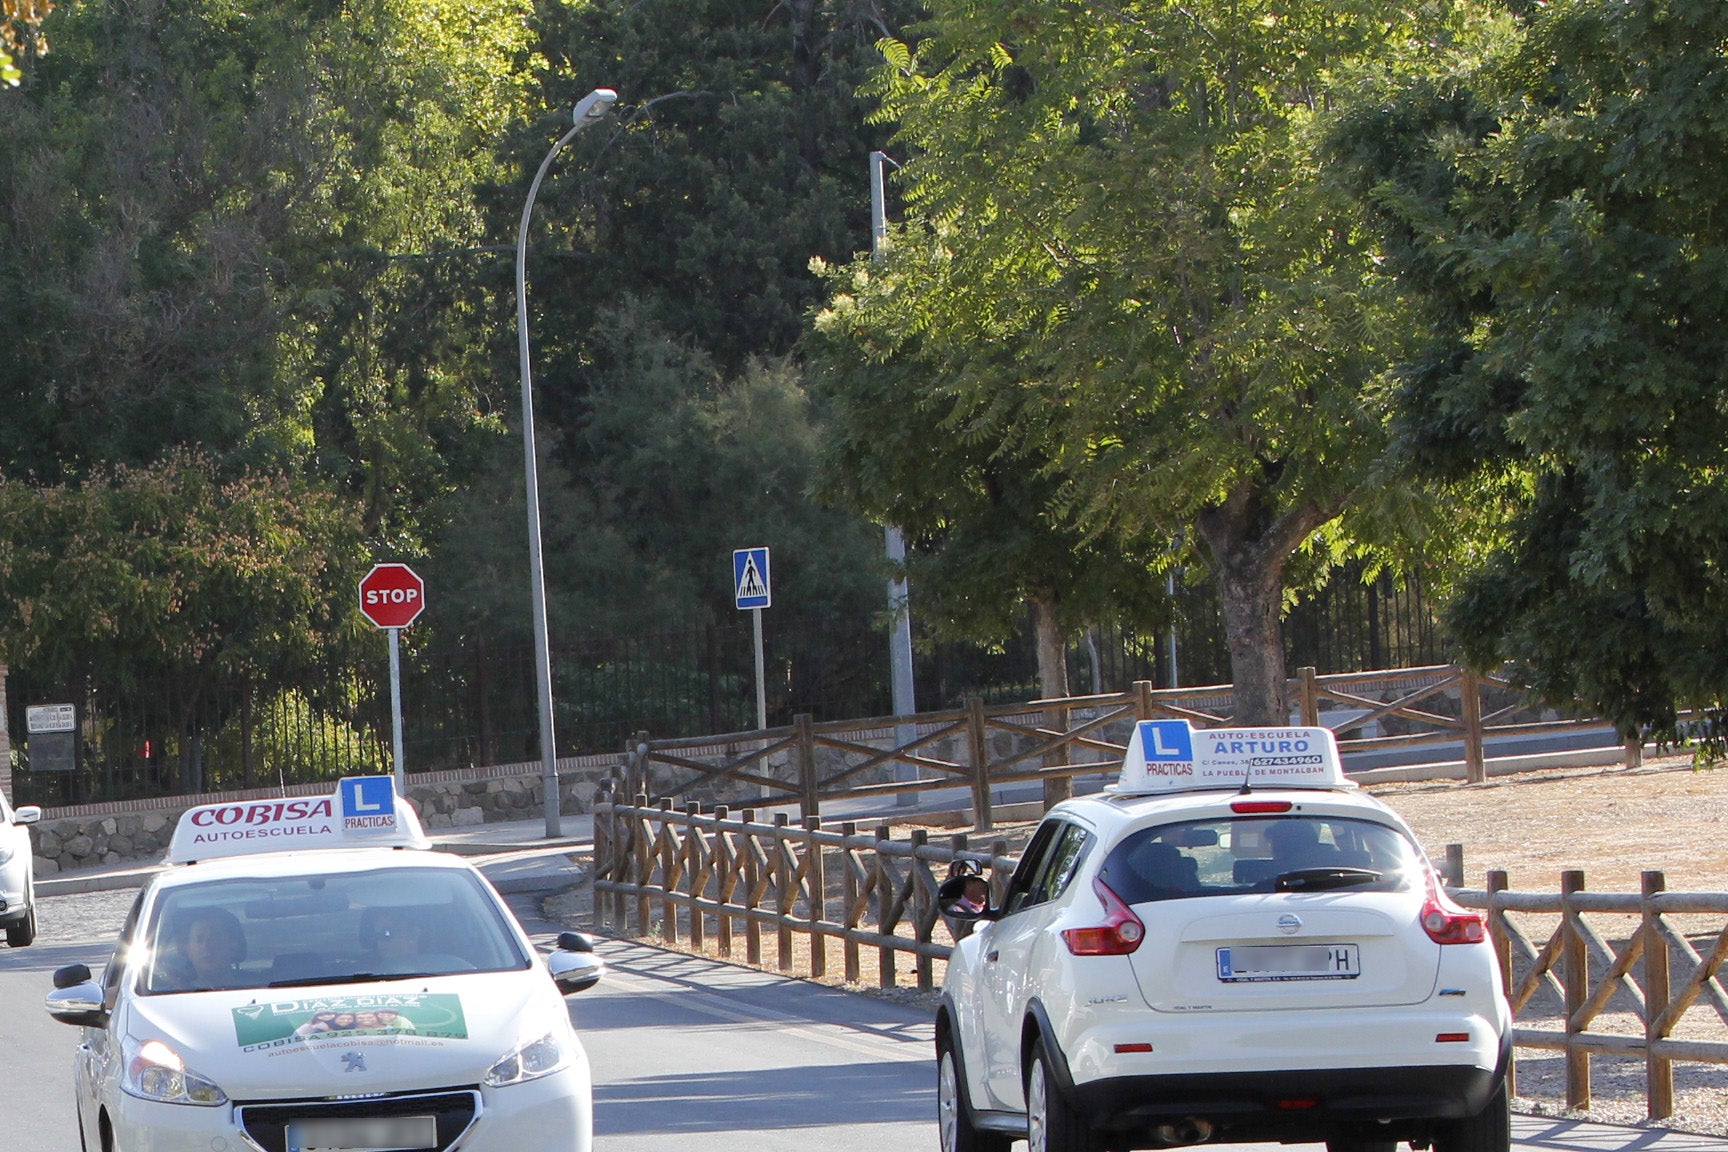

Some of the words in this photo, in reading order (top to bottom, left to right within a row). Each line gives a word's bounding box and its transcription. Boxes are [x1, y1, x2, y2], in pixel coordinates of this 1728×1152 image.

[366, 588, 418, 605] STOP
[1152, 727, 1179, 756] L
[1209, 731, 1311, 740] AUTO-ESCUELA
[1214, 740, 1309, 754] ARTURO
[1147, 763, 1193, 776] PRACTICAS
[1253, 756, 1321, 766] 627434960
[354, 784, 380, 811] L
[191, 800, 332, 827] COBISA
[345, 816, 394, 829] PRACTICAS
[194, 825, 332, 844] AUTOESCUELA
[243, 1034, 321, 1053] COBISA
[326, 1030, 368, 1038] 925
